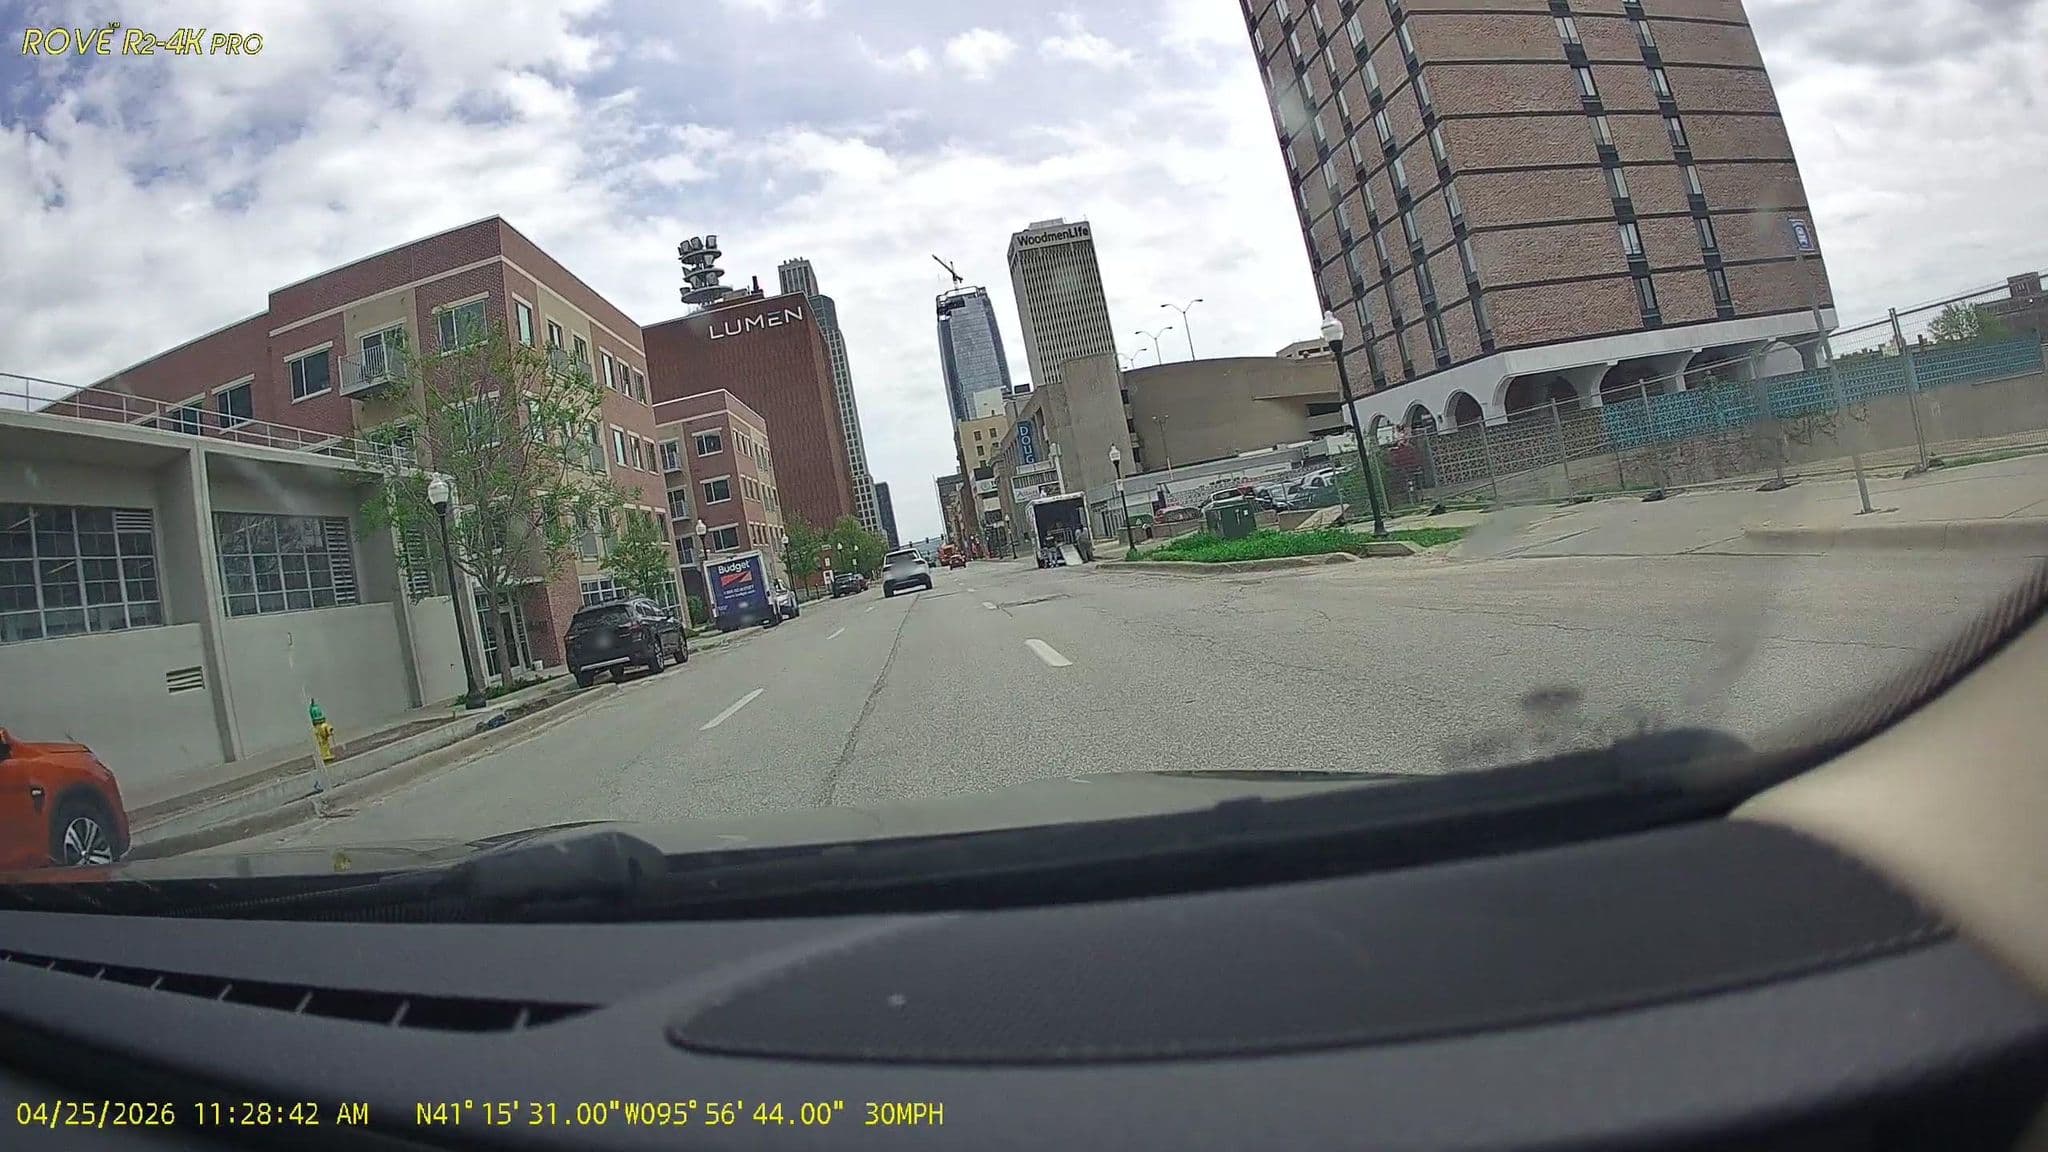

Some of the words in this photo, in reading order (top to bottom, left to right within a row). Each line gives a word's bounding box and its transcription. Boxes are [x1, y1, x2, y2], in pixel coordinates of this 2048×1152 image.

[1017, 226, 1089, 246] WoodmenLife
[709, 306, 803, 339] LUMEN
[718, 560, 750, 574] Budget
